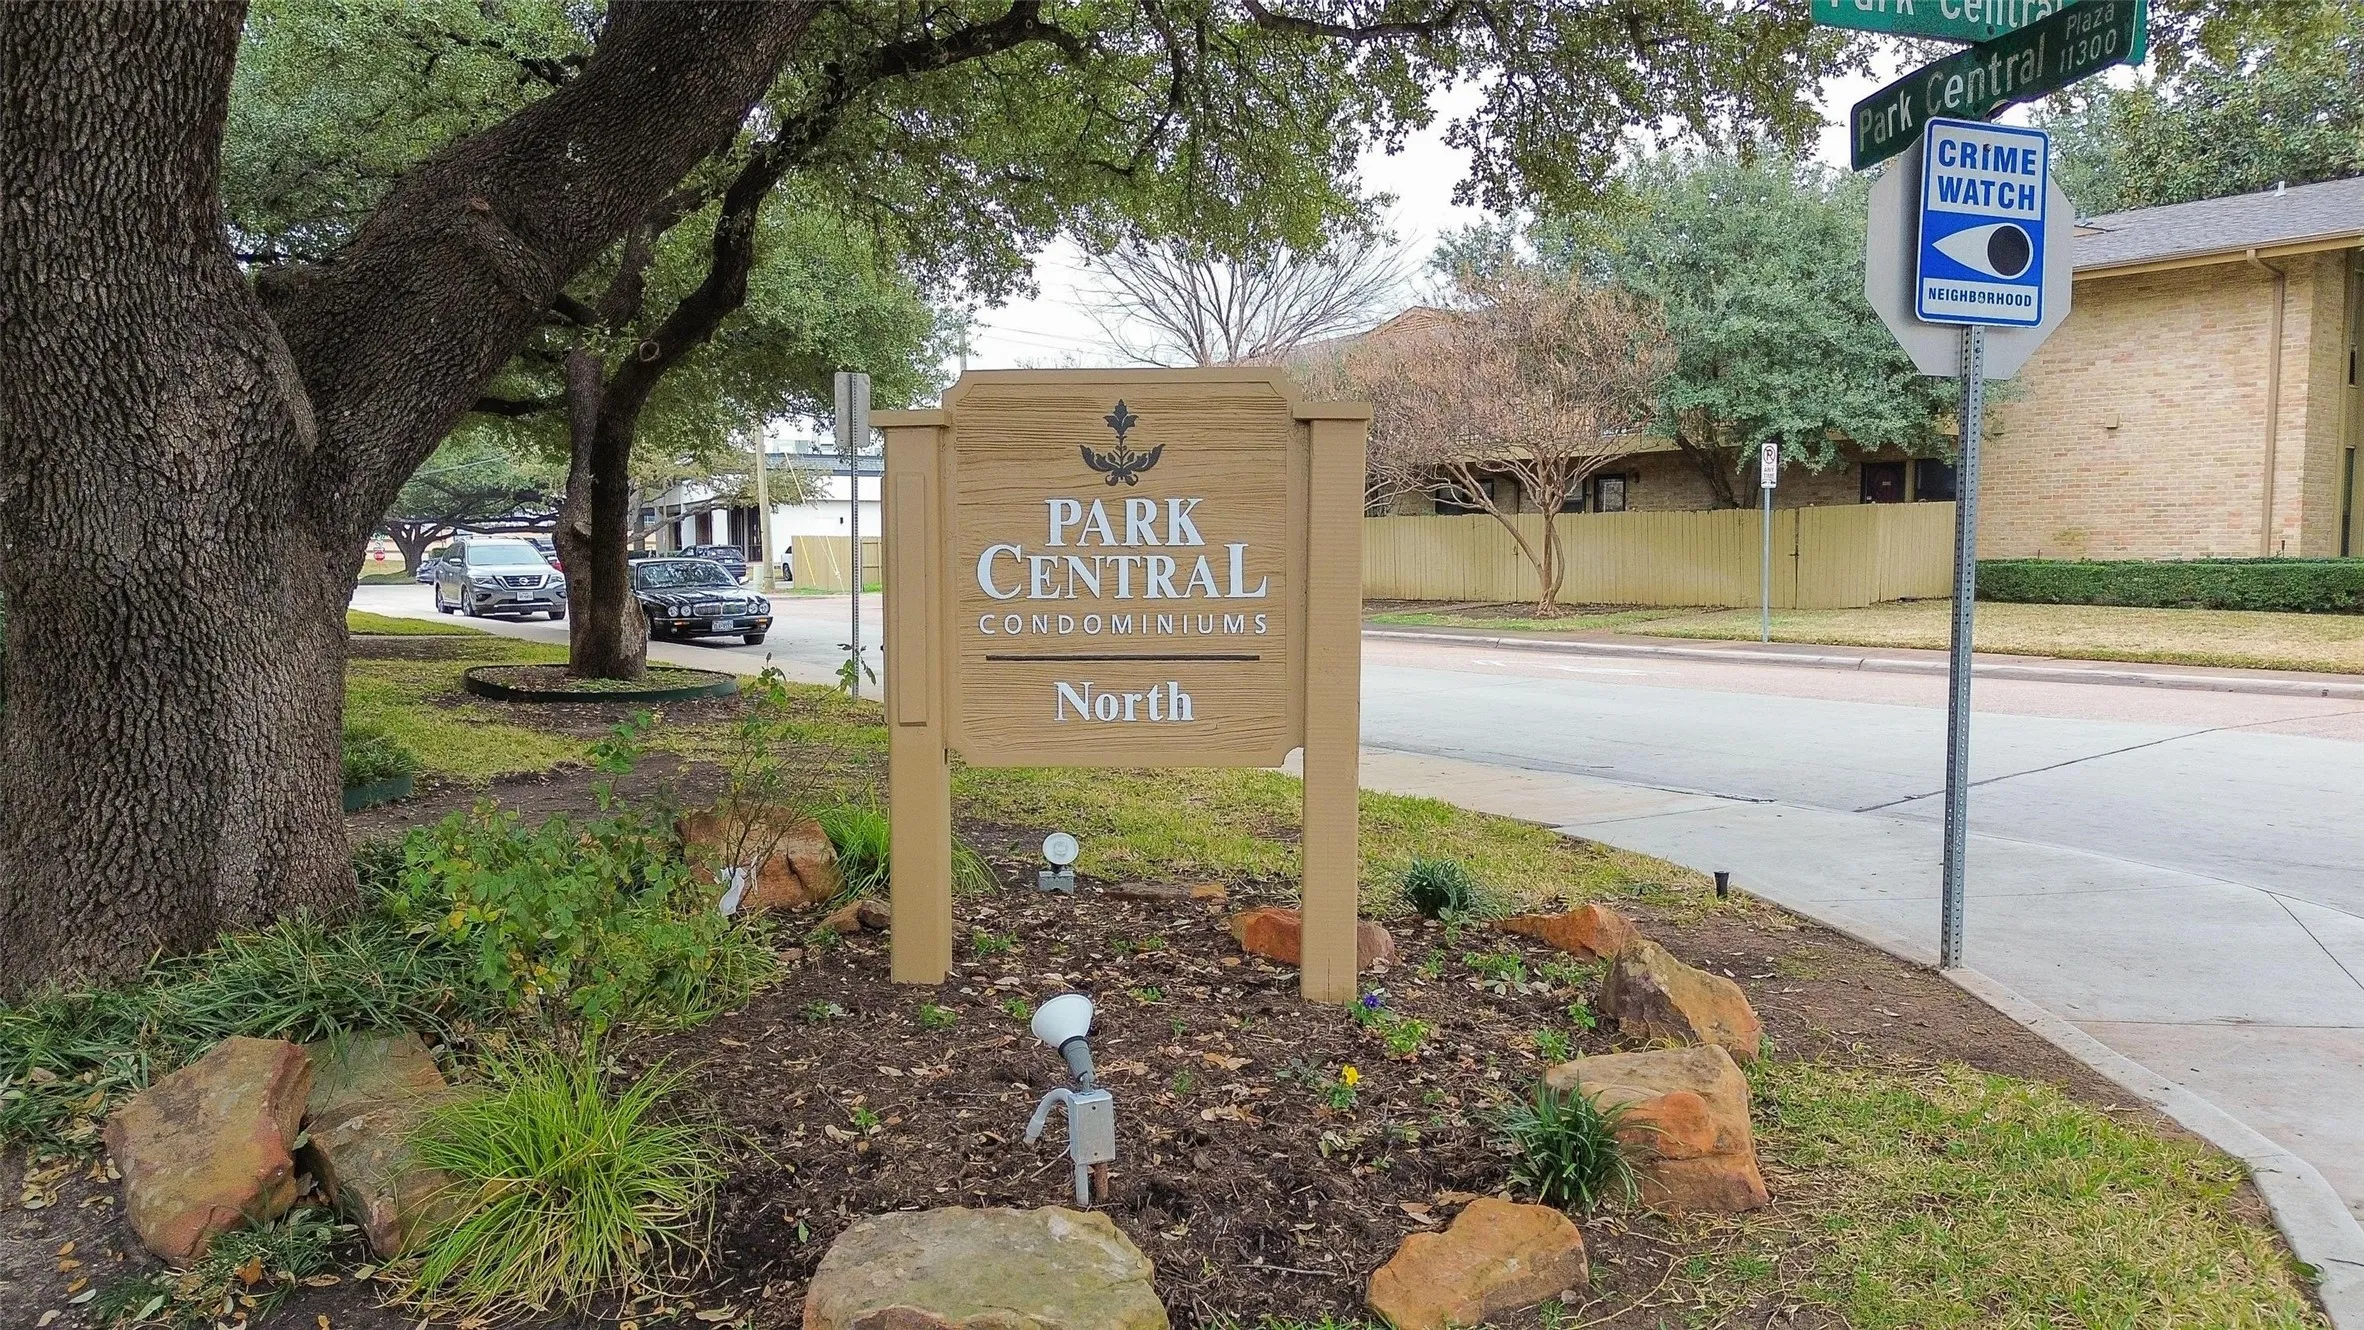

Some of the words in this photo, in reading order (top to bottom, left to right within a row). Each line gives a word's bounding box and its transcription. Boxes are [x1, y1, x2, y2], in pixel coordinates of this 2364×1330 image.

[1940, 0, 2062, 27] entra
[2066, 2, 2115, 40] Plaza
[2060, 28, 2117, 74] 11300
[1859, 90, 1913, 152] Park
[1925, 32, 2046, 115] Central
[1938, 139, 2037, 176] CRIME
[1937, 175, 2035, 211] WATCH
[1928, 287, 2032, 307] NEIGHBORHOOD
[1045, 498, 1206, 547] PARK
[976, 543, 1268, 600] CENTRAL
[979, 613, 1268, 635] CONDOMINIUMS
[1053, 681, 1195, 722] North
